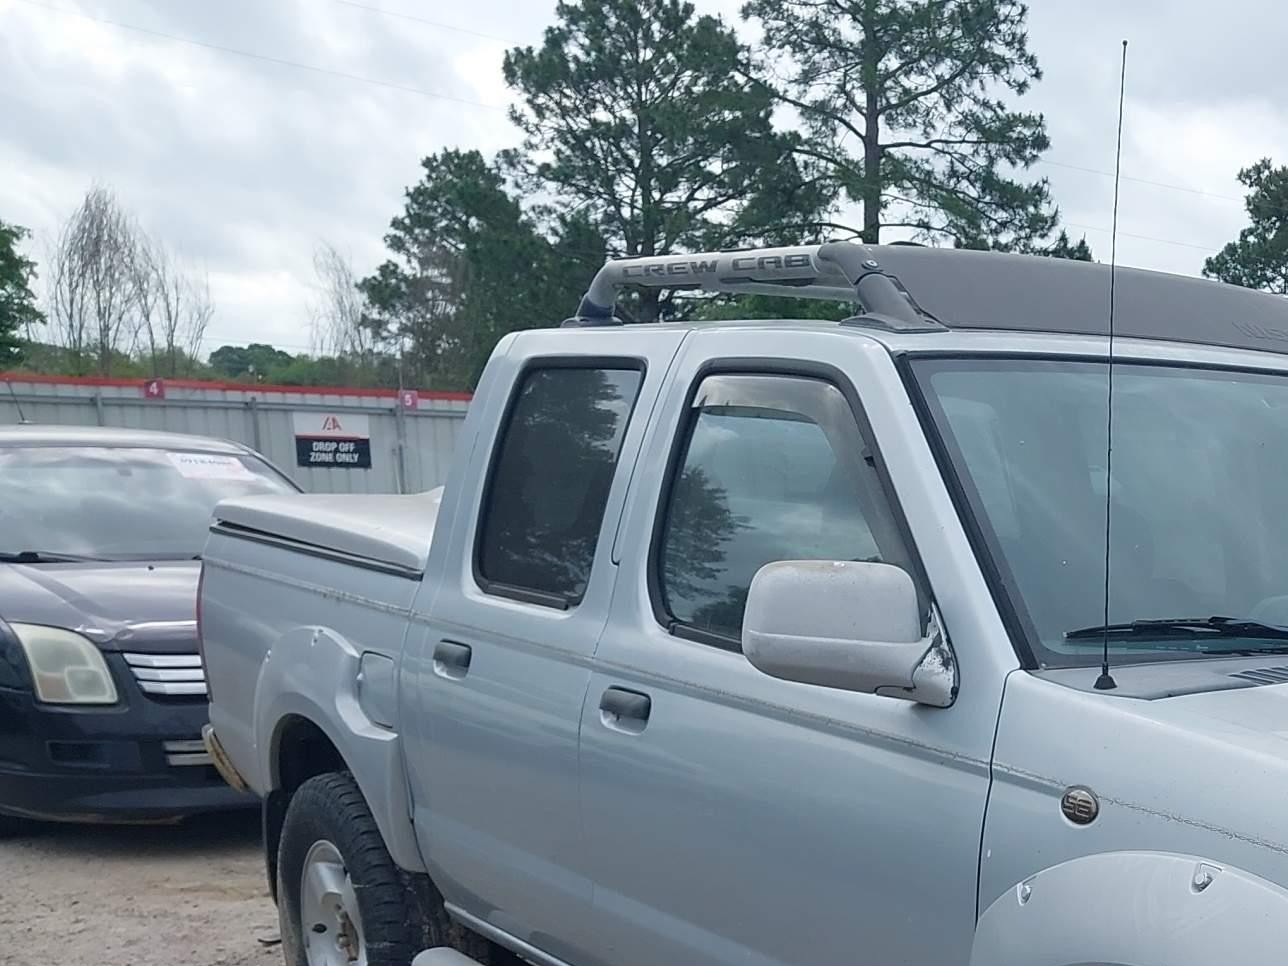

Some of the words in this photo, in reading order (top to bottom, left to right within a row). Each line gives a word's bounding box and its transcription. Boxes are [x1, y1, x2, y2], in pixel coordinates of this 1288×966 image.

[622, 260, 719, 278] CREW
[732, 253, 810, 271] CAB
[149, 381, 159, 395] 4
[404, 394, 413, 406] 5
[312, 441, 337, 452] DROP
[338, 442, 355, 452] OFF
[309, 451, 334, 462] ZONE
[335, 452, 358, 463] ONLY
[1063, 793, 1093, 818] SE
